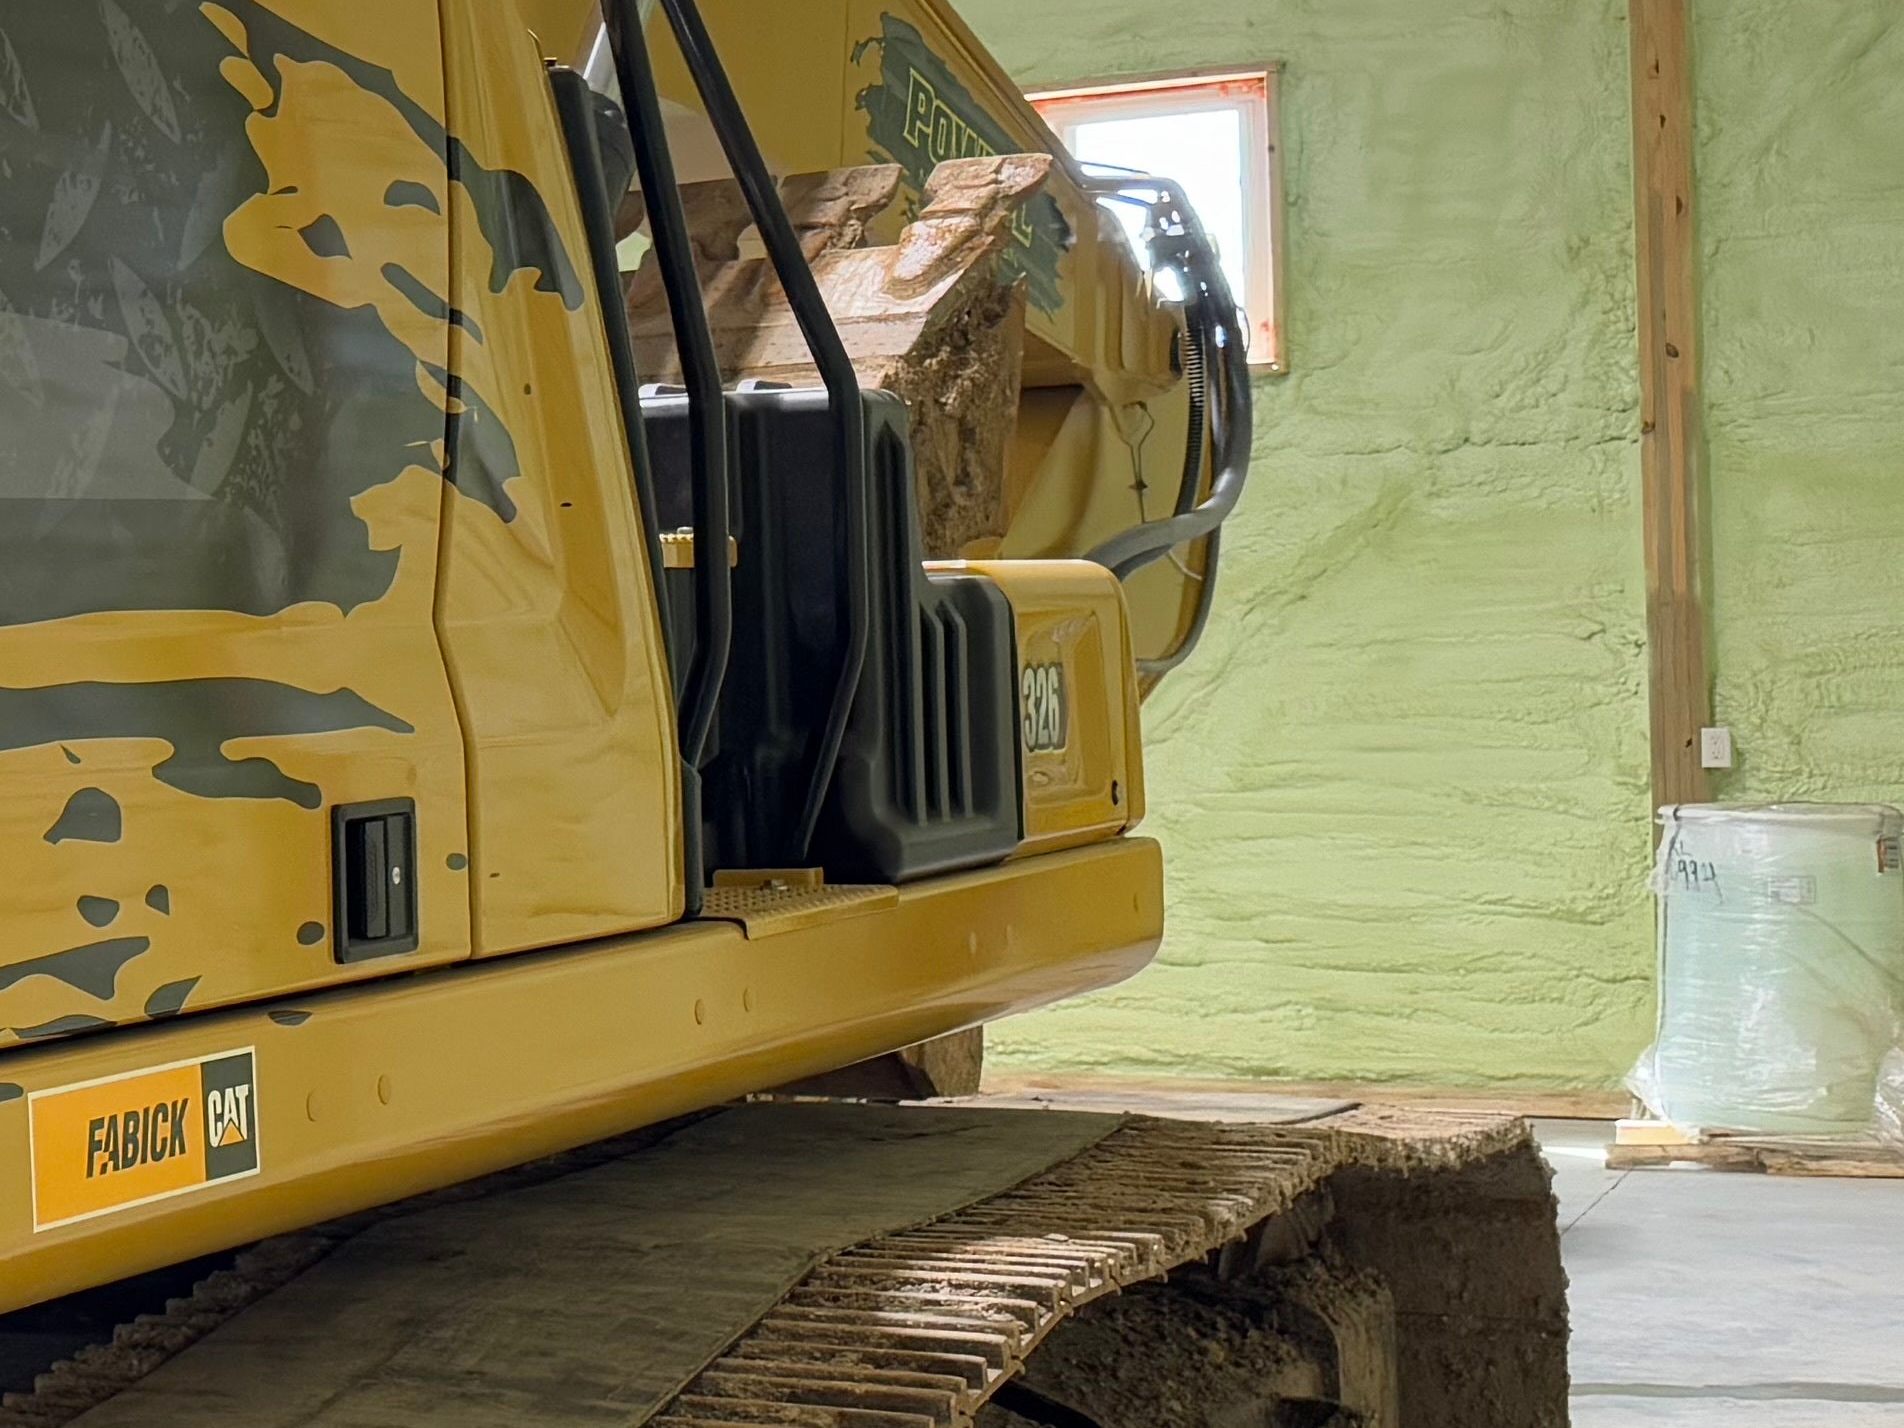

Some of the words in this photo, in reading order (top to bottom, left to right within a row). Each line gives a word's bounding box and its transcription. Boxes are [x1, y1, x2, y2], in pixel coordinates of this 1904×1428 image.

[1023, 666, 1060, 749] 326
[85, 1098, 190, 1179] FABICK
[207, 1083, 250, 1149] CAT
